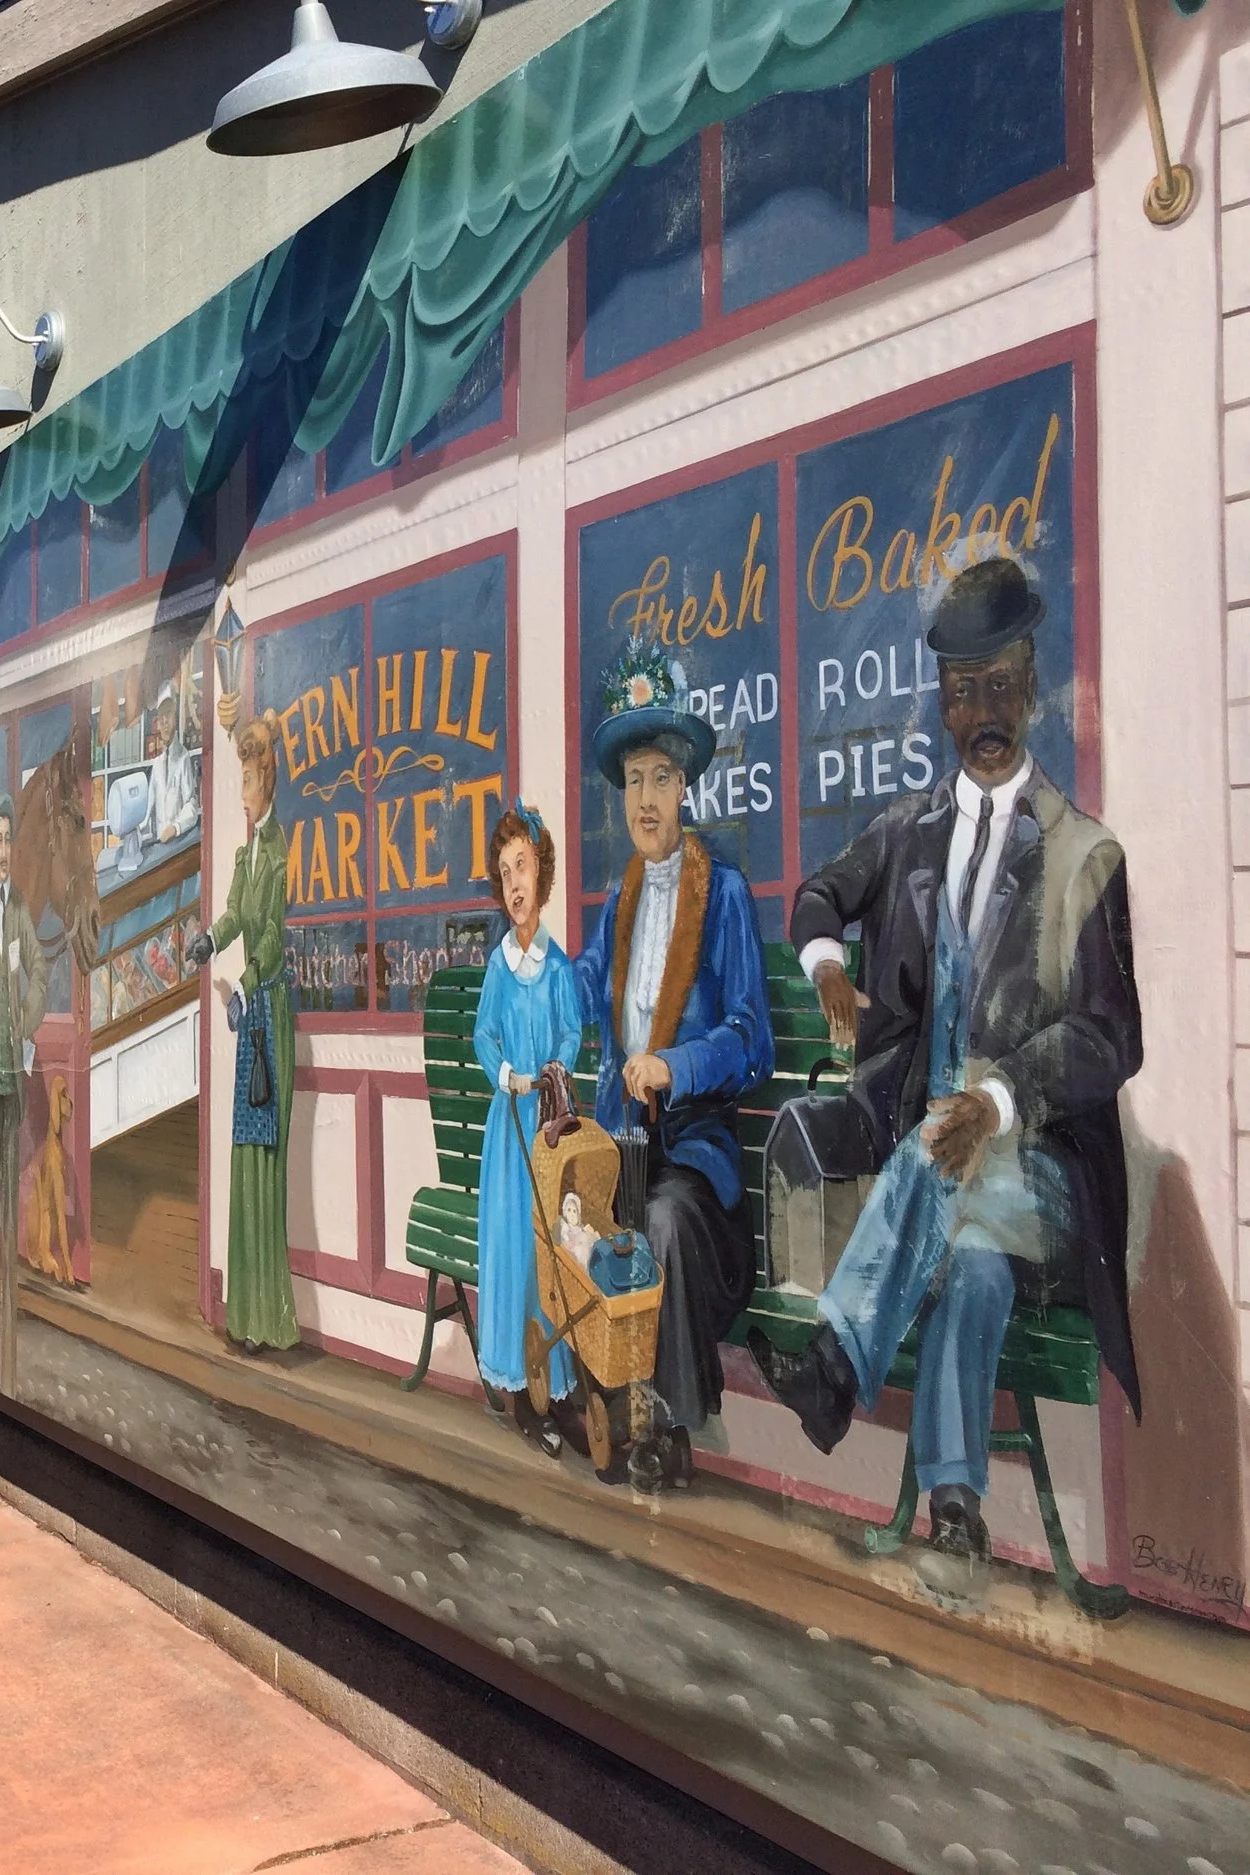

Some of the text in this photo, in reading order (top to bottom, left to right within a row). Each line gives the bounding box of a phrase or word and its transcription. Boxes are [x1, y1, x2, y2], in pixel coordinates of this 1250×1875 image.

[608, 413, 1060, 647] Fresh Baked
[276, 648, 498, 783] ERN HILL
[689, 672, 779, 732] READ
[682, 762, 773, 821] AKES
[819, 733, 934, 802] PIES
[280, 774, 503, 905] MARKET
